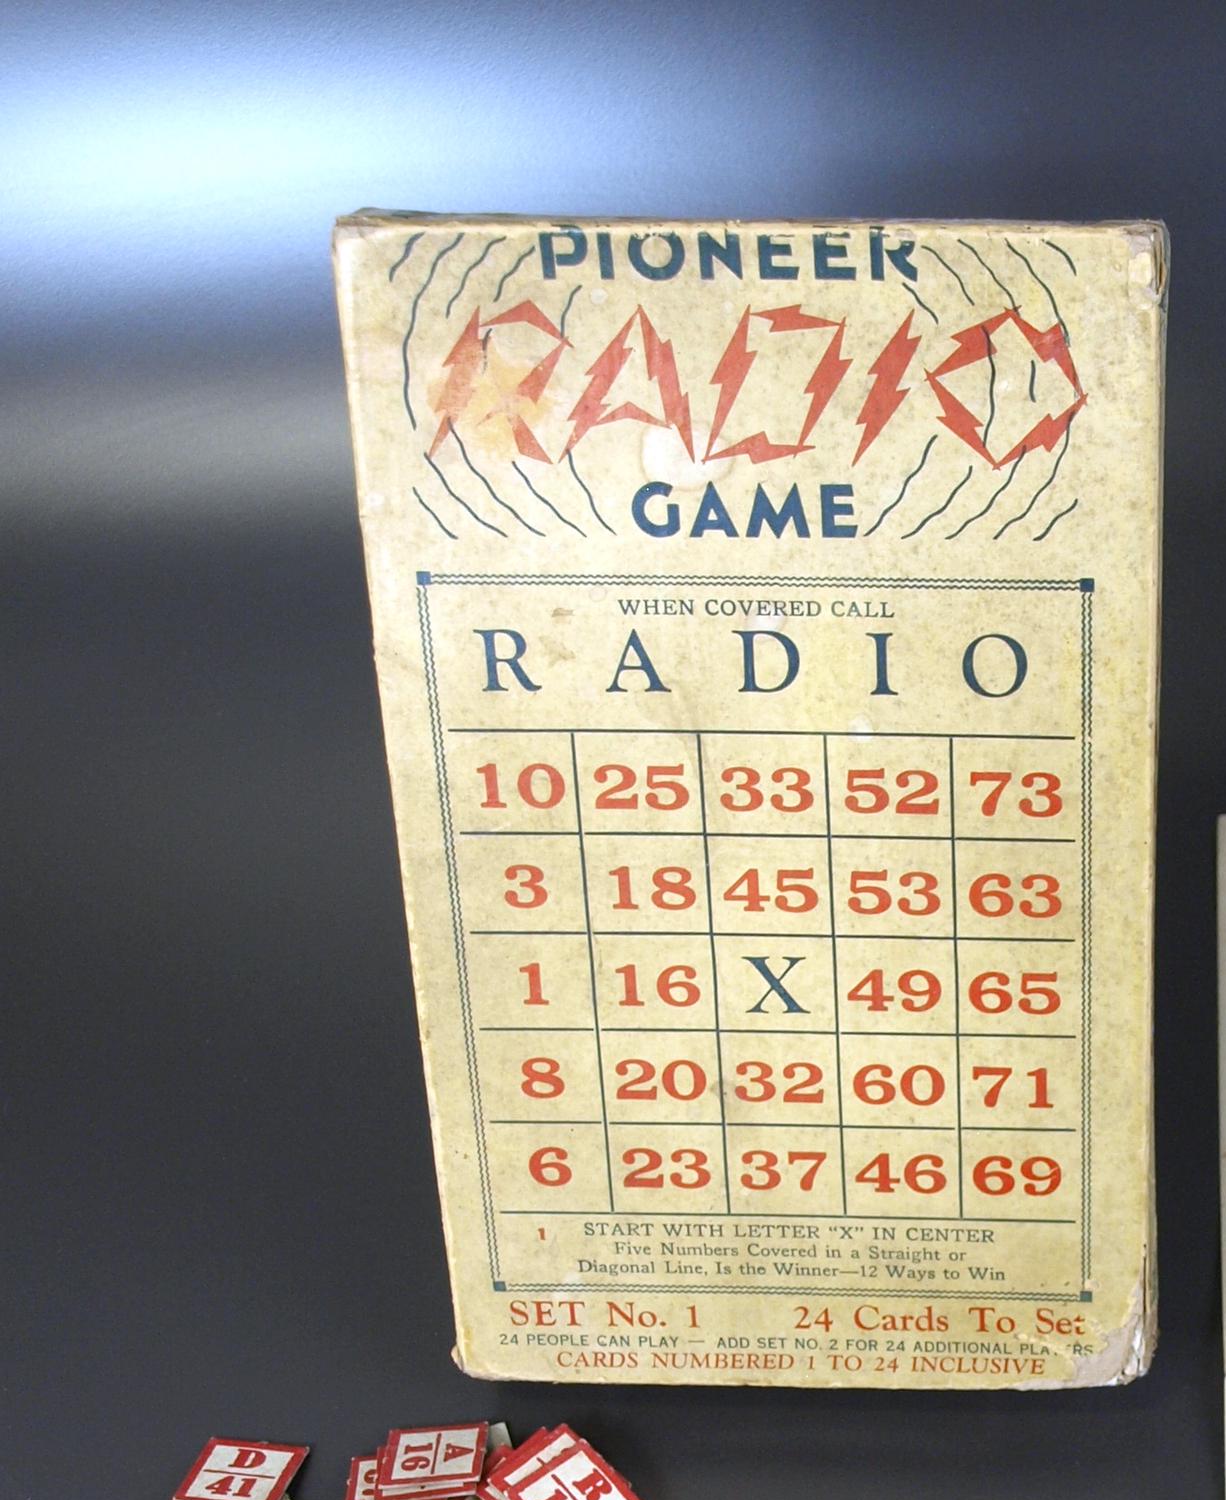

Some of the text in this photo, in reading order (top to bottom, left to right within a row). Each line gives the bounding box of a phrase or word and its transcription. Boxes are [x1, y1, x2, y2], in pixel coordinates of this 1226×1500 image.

[536, 223, 922, 282] PIONEER
[425, 299, 1089, 470] RADIO
[632, 481, 858, 539] GAME
[618, 599, 895, 618] WHEN COVERED CALL
[477, 763, 1062, 817] 10 25 33 52 73
[529, 1147, 1061, 1196] 6 23 37 46 69
[538, 1228, 545, 1240] 1
[584, 1223, 654, 1236] START
[663, 1224, 723, 1237] WITH
[734, 1225, 819, 1238] LETTER
[873, 1227, 895, 1240] IN
[906, 1228, 994, 1243] CENTER
[615, 1242, 966, 1264] Five Numbers Covered in a Straight or
[578, 1260, 654, 1276] Diagonal
[664, 1261, 707, 1275] Line,
[716, 1262, 731, 1274] Is
[739, 1262, 766, 1275] the
[888, 1265, 935, 1281] Ways
[943, 1269, 960, 1279] to
[968, 1267, 1005, 1280] Win
[510, 1301, 698, 1327] SET No. 1
[795, 1306, 1084, 1335] 24 Cards To Set
[500, 1334, 1094, 1358] 24 PEOPLE CAN PLAY ADD SET NO. 2 FOR 24 ADDITIONAL PLARS
[557, 1352, 1045, 1374] CARDS NUMBERED 1 TO 24 INCLUSIVE
[228, 1449, 266, 1468] D
[400, 1441, 434, 1473] 16
[444, 1441, 475, 1463] A
[206, 1476, 257, 1497] 41
